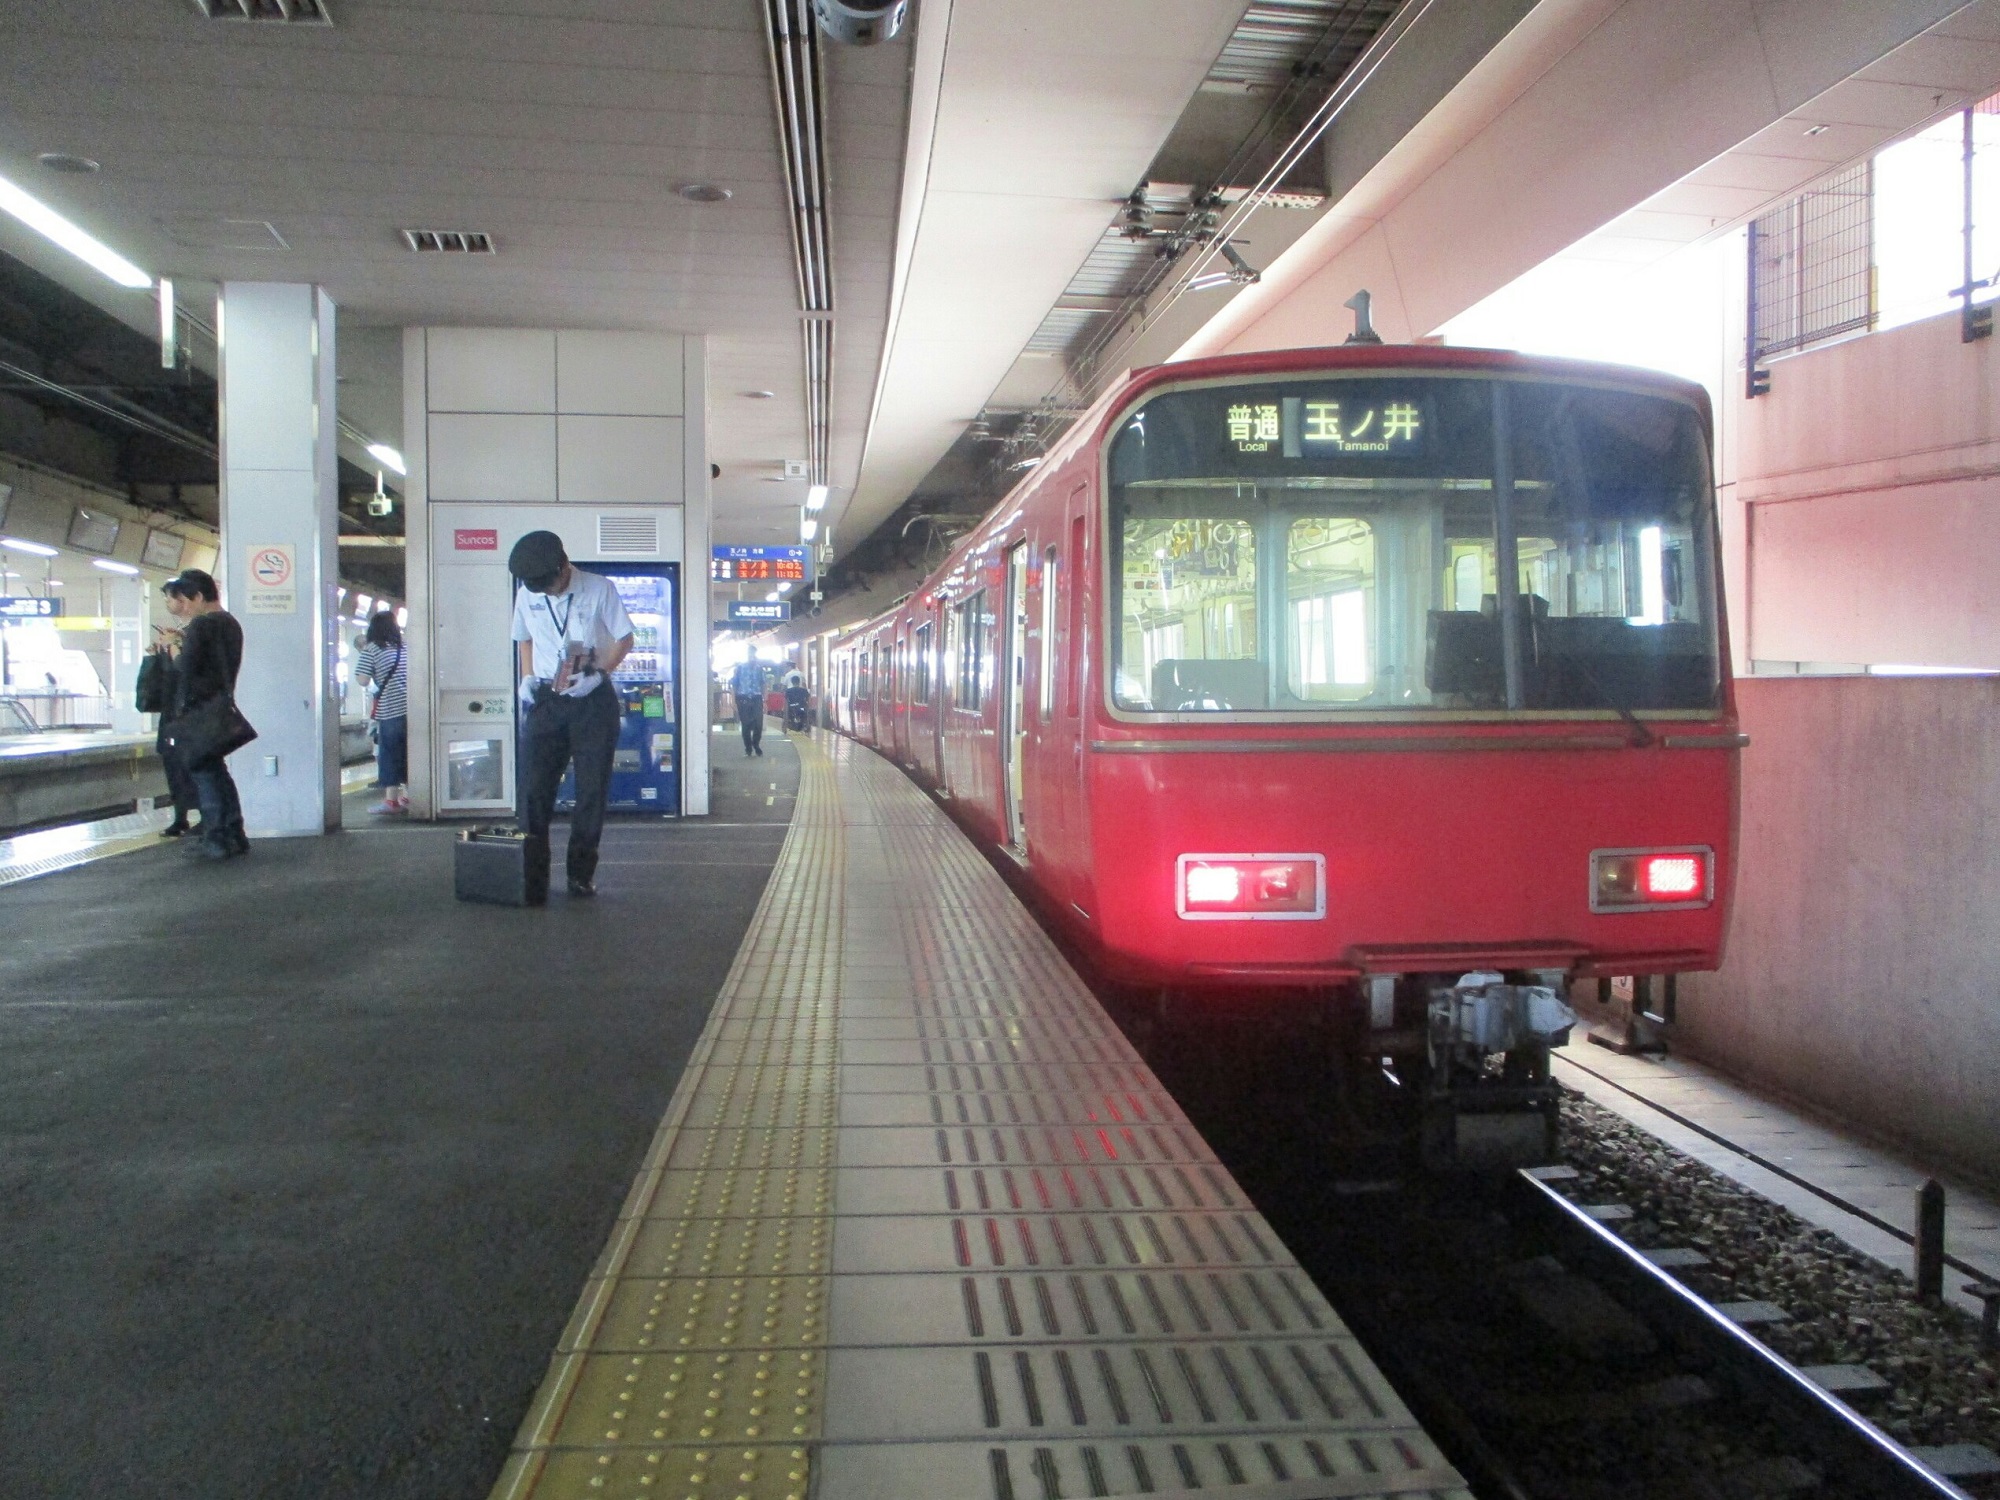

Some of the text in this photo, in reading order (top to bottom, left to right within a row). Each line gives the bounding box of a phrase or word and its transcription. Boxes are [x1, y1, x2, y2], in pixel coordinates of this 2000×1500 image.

[1228, 404, 1279, 441] 普通
[1305, 403, 1420, 440] 玉ノ井
[1239, 442, 1268, 452] Local
[1337, 440, 1389, 451] Tamanoi
[457, 534, 496, 545] Suncos
[40, 600, 51, 614] 3
[774, 605, 782, 618] 1
